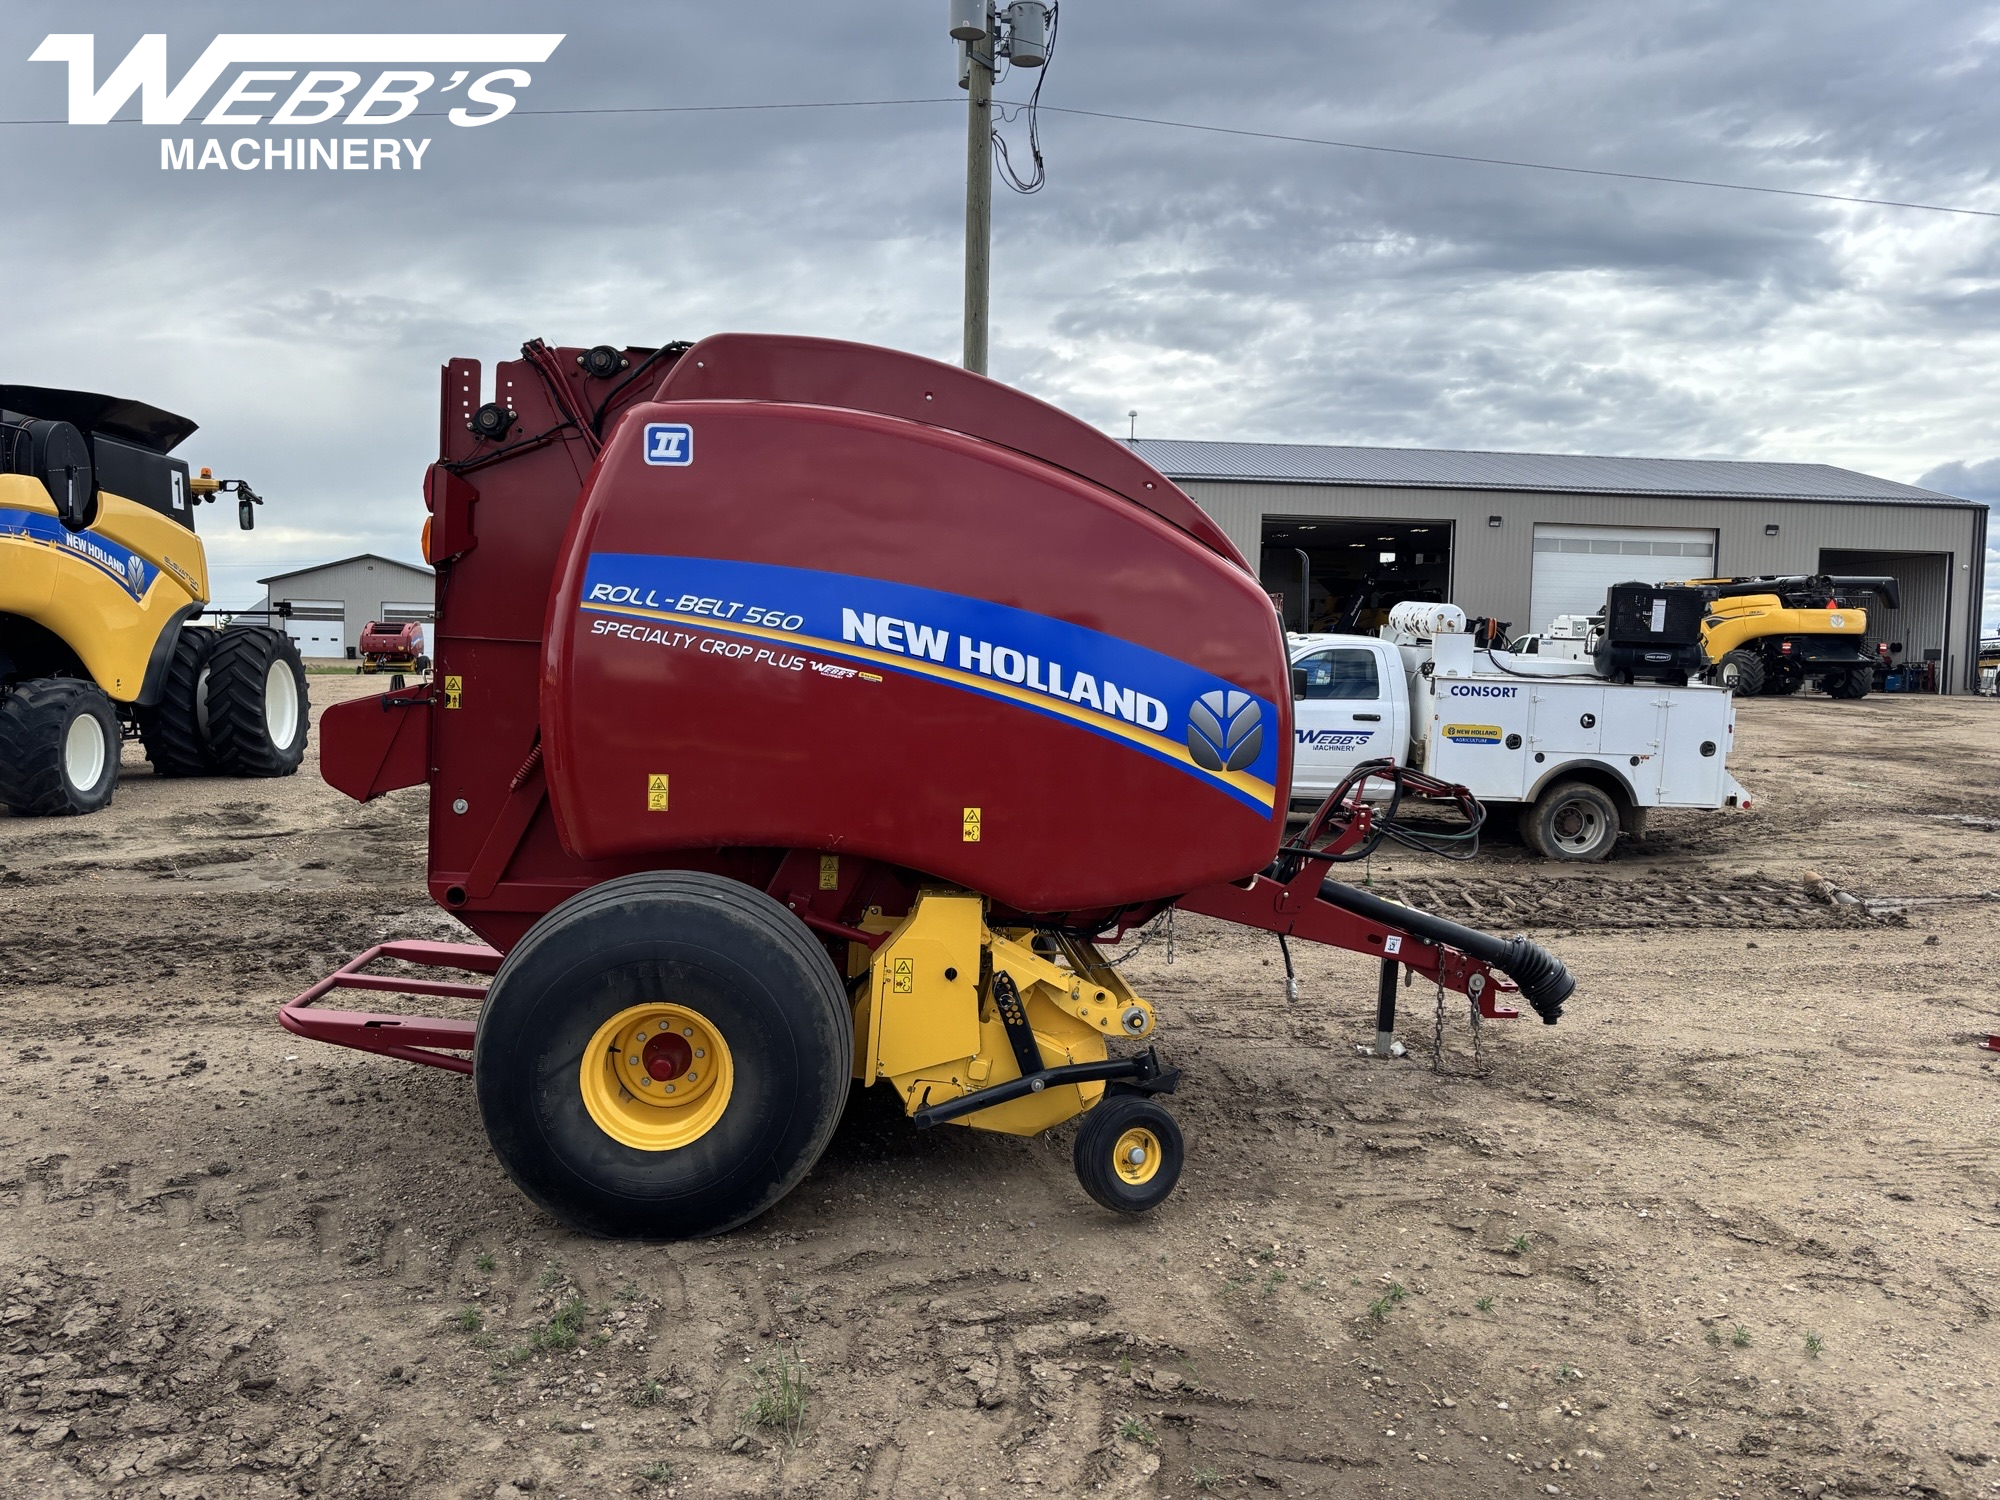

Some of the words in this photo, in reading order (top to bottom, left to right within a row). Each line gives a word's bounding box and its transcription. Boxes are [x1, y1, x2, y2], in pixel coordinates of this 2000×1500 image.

[174, 477, 182, 504] 1
[66, 532, 87, 553] NEW
[88, 542, 126, 576] HOLLAND
[742, 606, 804, 631] 560
[591, 619, 698, 649] SPECIALTY
[699, 638, 754, 659] CROP
[754, 648, 806, 671] PLUS
[842, 607, 949, 663] NEW
[959, 635, 1169, 732] HOLLAND
[1451, 685, 1518, 698] CONSORT
[1295, 729, 1375, 745] WEBB'S
[1312, 744, 1356, 752] MACHINERY
